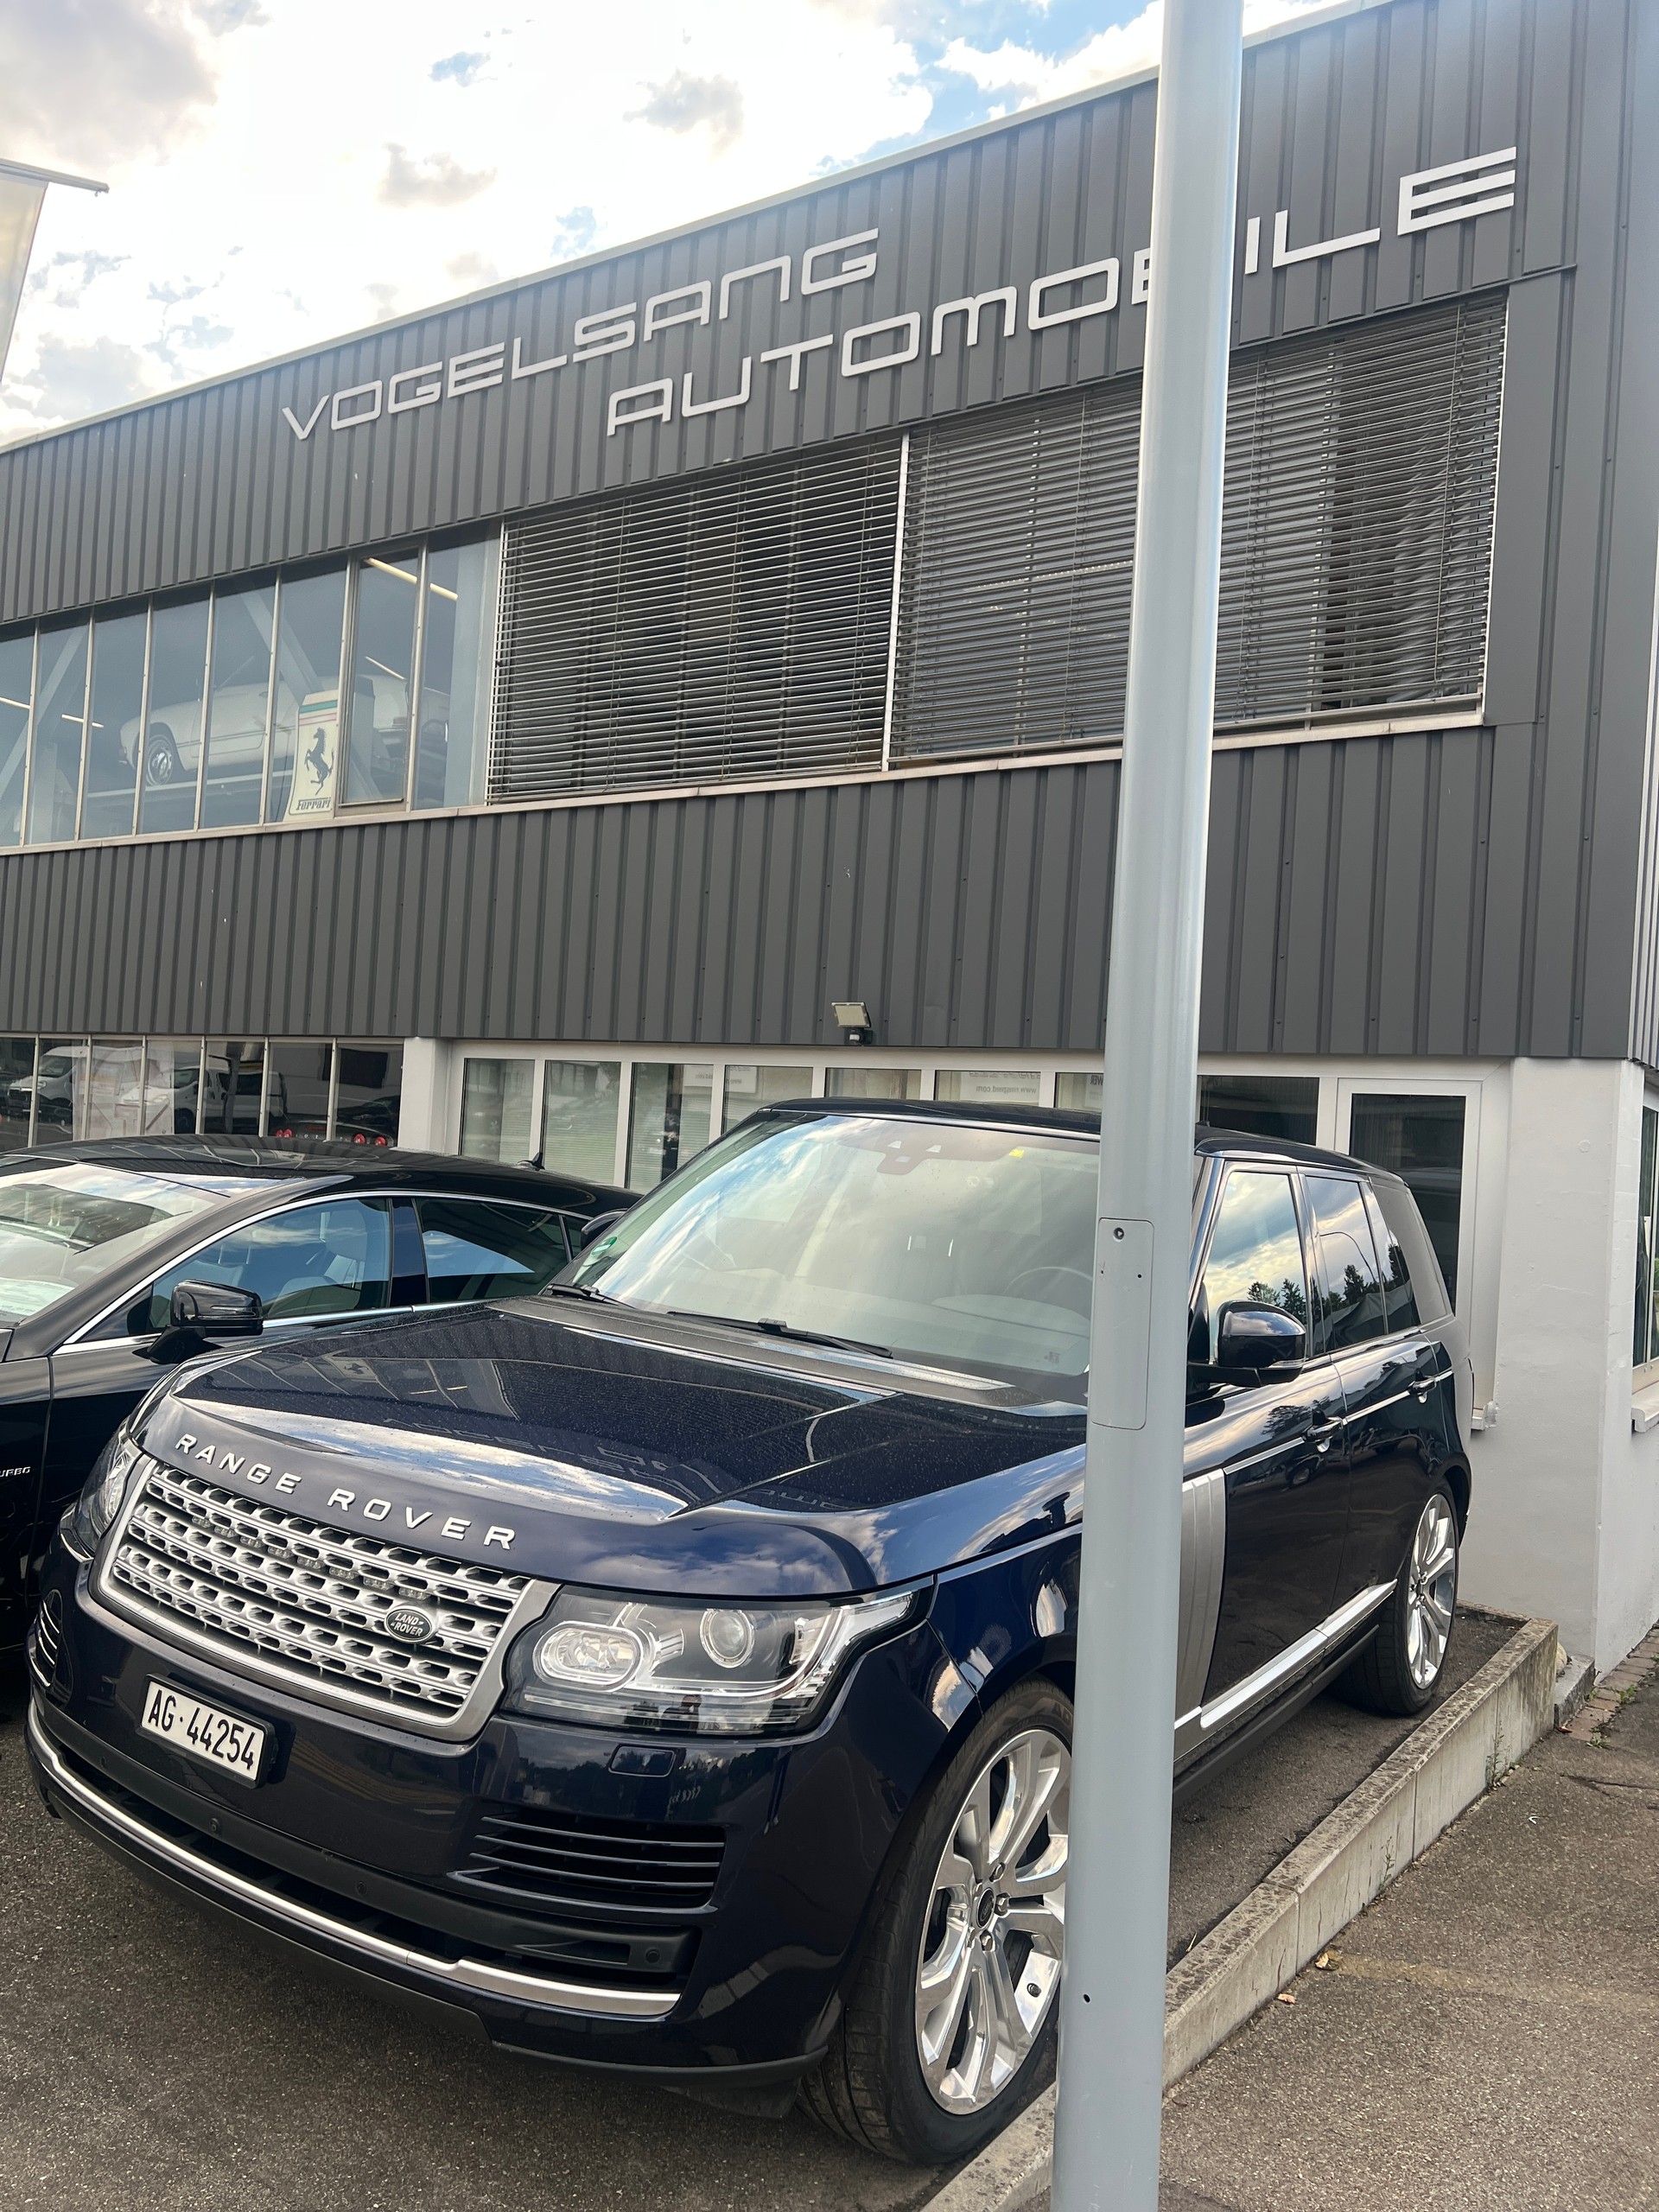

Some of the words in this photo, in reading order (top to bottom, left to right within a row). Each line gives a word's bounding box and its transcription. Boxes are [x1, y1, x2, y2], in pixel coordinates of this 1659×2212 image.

[607, 146, 1517, 437] AUTOMOILE
[282, 228, 879, 441] VOGELSANG
[296, 797, 332, 810] Ferrari
[175, 1433, 302, 1495] RANGE
[327, 1487, 516, 1550] ROVER
[394, 1622, 423, 1637] ROVER
[395, 1612, 419, 1625] LAND
[186, 1707, 256, 1770] 44254
